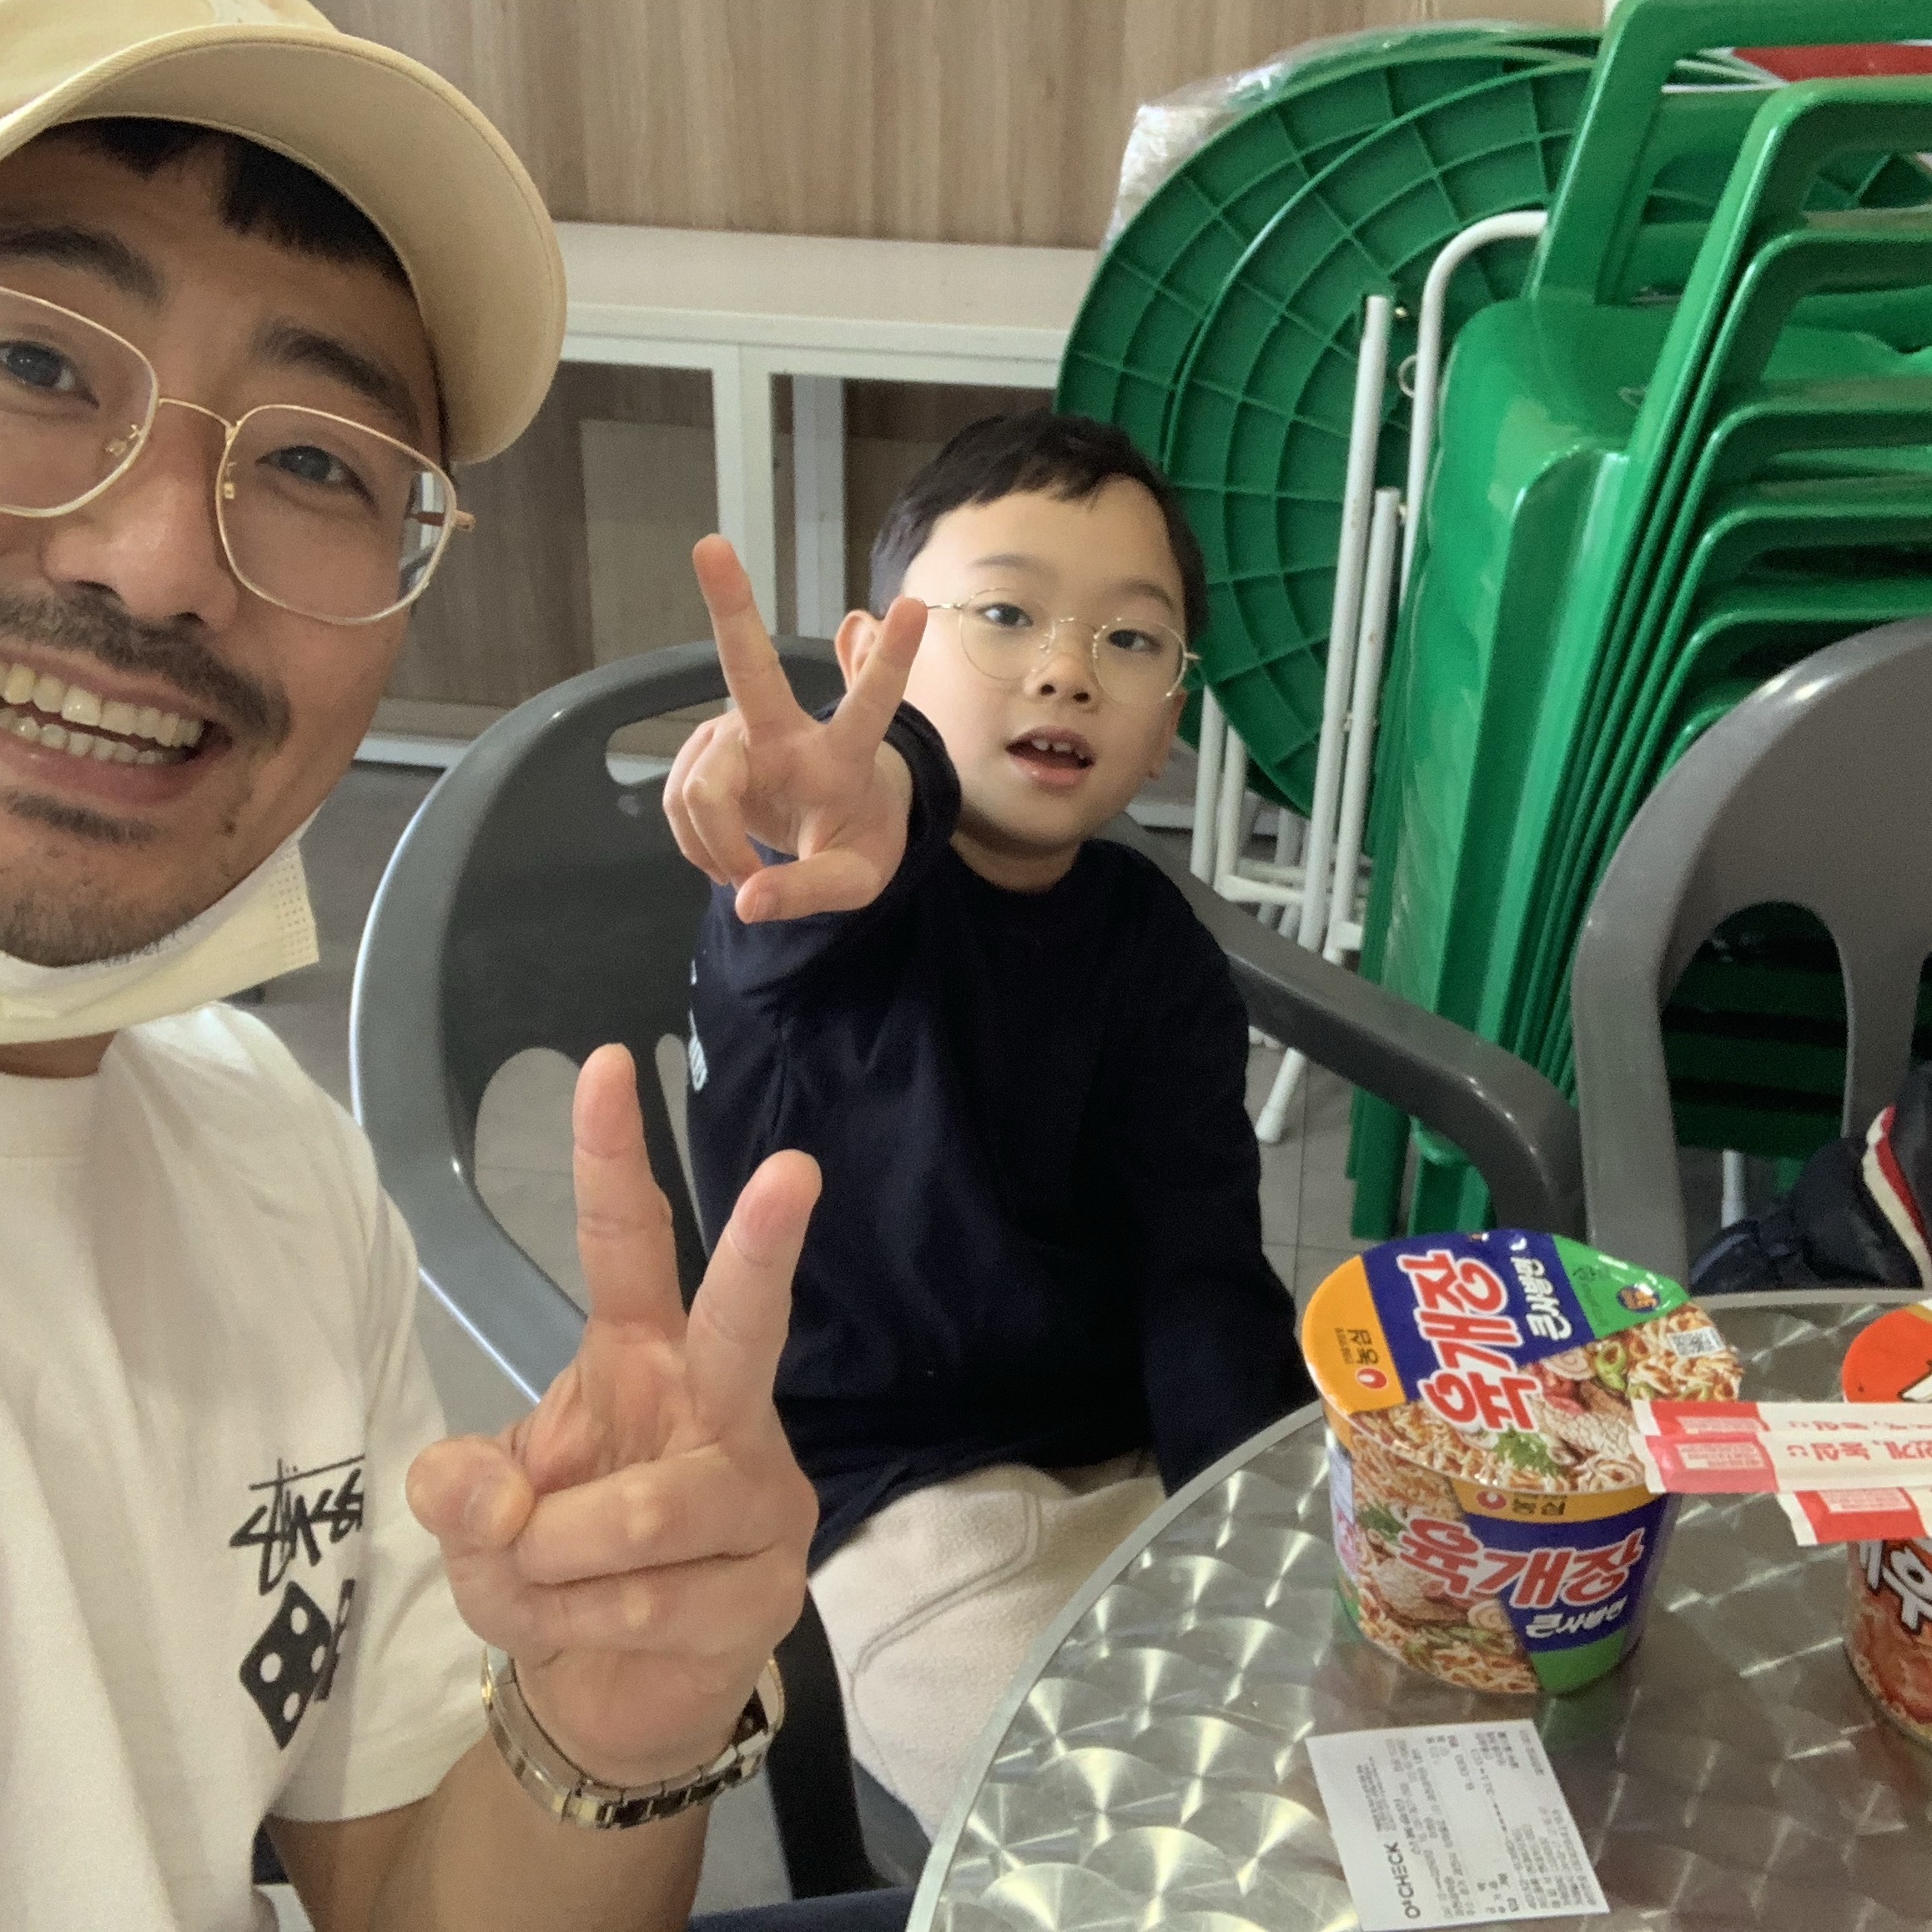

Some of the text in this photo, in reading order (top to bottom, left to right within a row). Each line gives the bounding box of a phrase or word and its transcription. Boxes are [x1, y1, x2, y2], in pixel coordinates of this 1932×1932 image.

[1397, 1249, 1542, 1433] 육개장
[1511, 1255, 1573, 1341] 큰사발면
[1346, 1329, 1379, 1364] 농심
[1397, 1515, 1645, 1610] 육개장
[1525, 1597, 1627, 1638] 큰사발면
